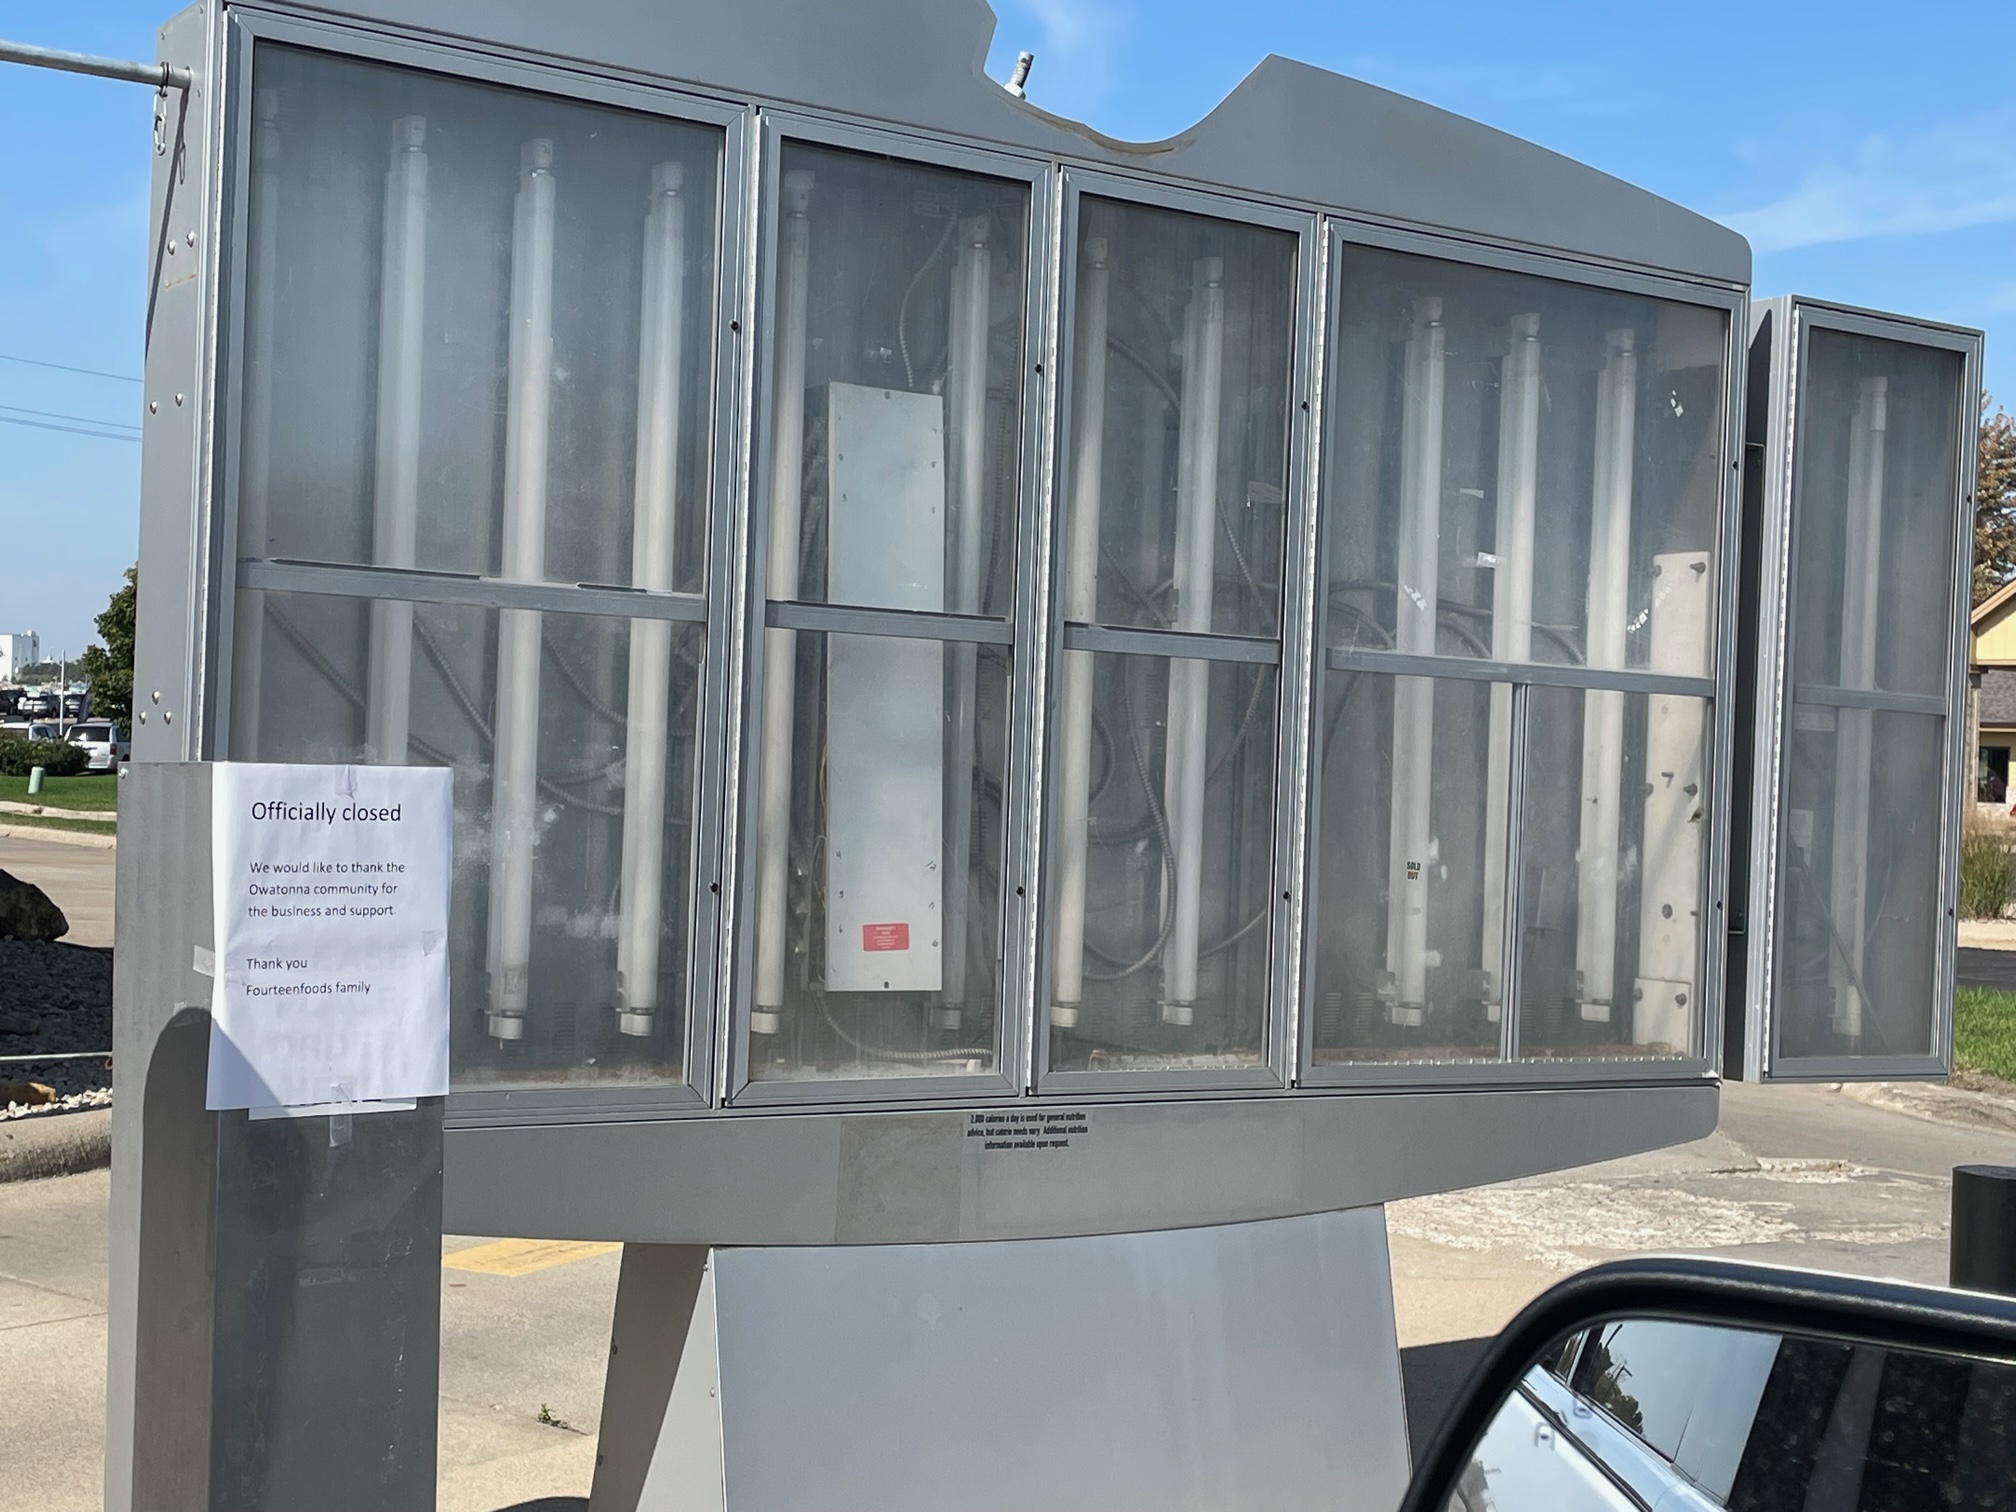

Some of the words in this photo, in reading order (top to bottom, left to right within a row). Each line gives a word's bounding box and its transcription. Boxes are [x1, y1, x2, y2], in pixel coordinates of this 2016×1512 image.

[251, 802, 336, 825] Officially
[342, 803, 402, 822] closed
[249, 862, 270, 873] We
[273, 861, 309, 874] would
[313, 861, 333, 874] like
[336, 863, 348, 873] to
[351, 861, 383, 873] thank
[386, 861, 405, 873] the
[249, 883, 310, 895] Owatonna
[313, 883, 378, 896] community
[381, 883, 397, 894] for
[248, 905, 268, 917] the
[271, 905, 321, 917] business
[325, 905, 346, 916] and
[246, 958, 282, 970] Thank
[286, 959, 308, 971] you
[246, 982, 333, 996] Fourteenfoods
[335, 981, 371, 995] family
